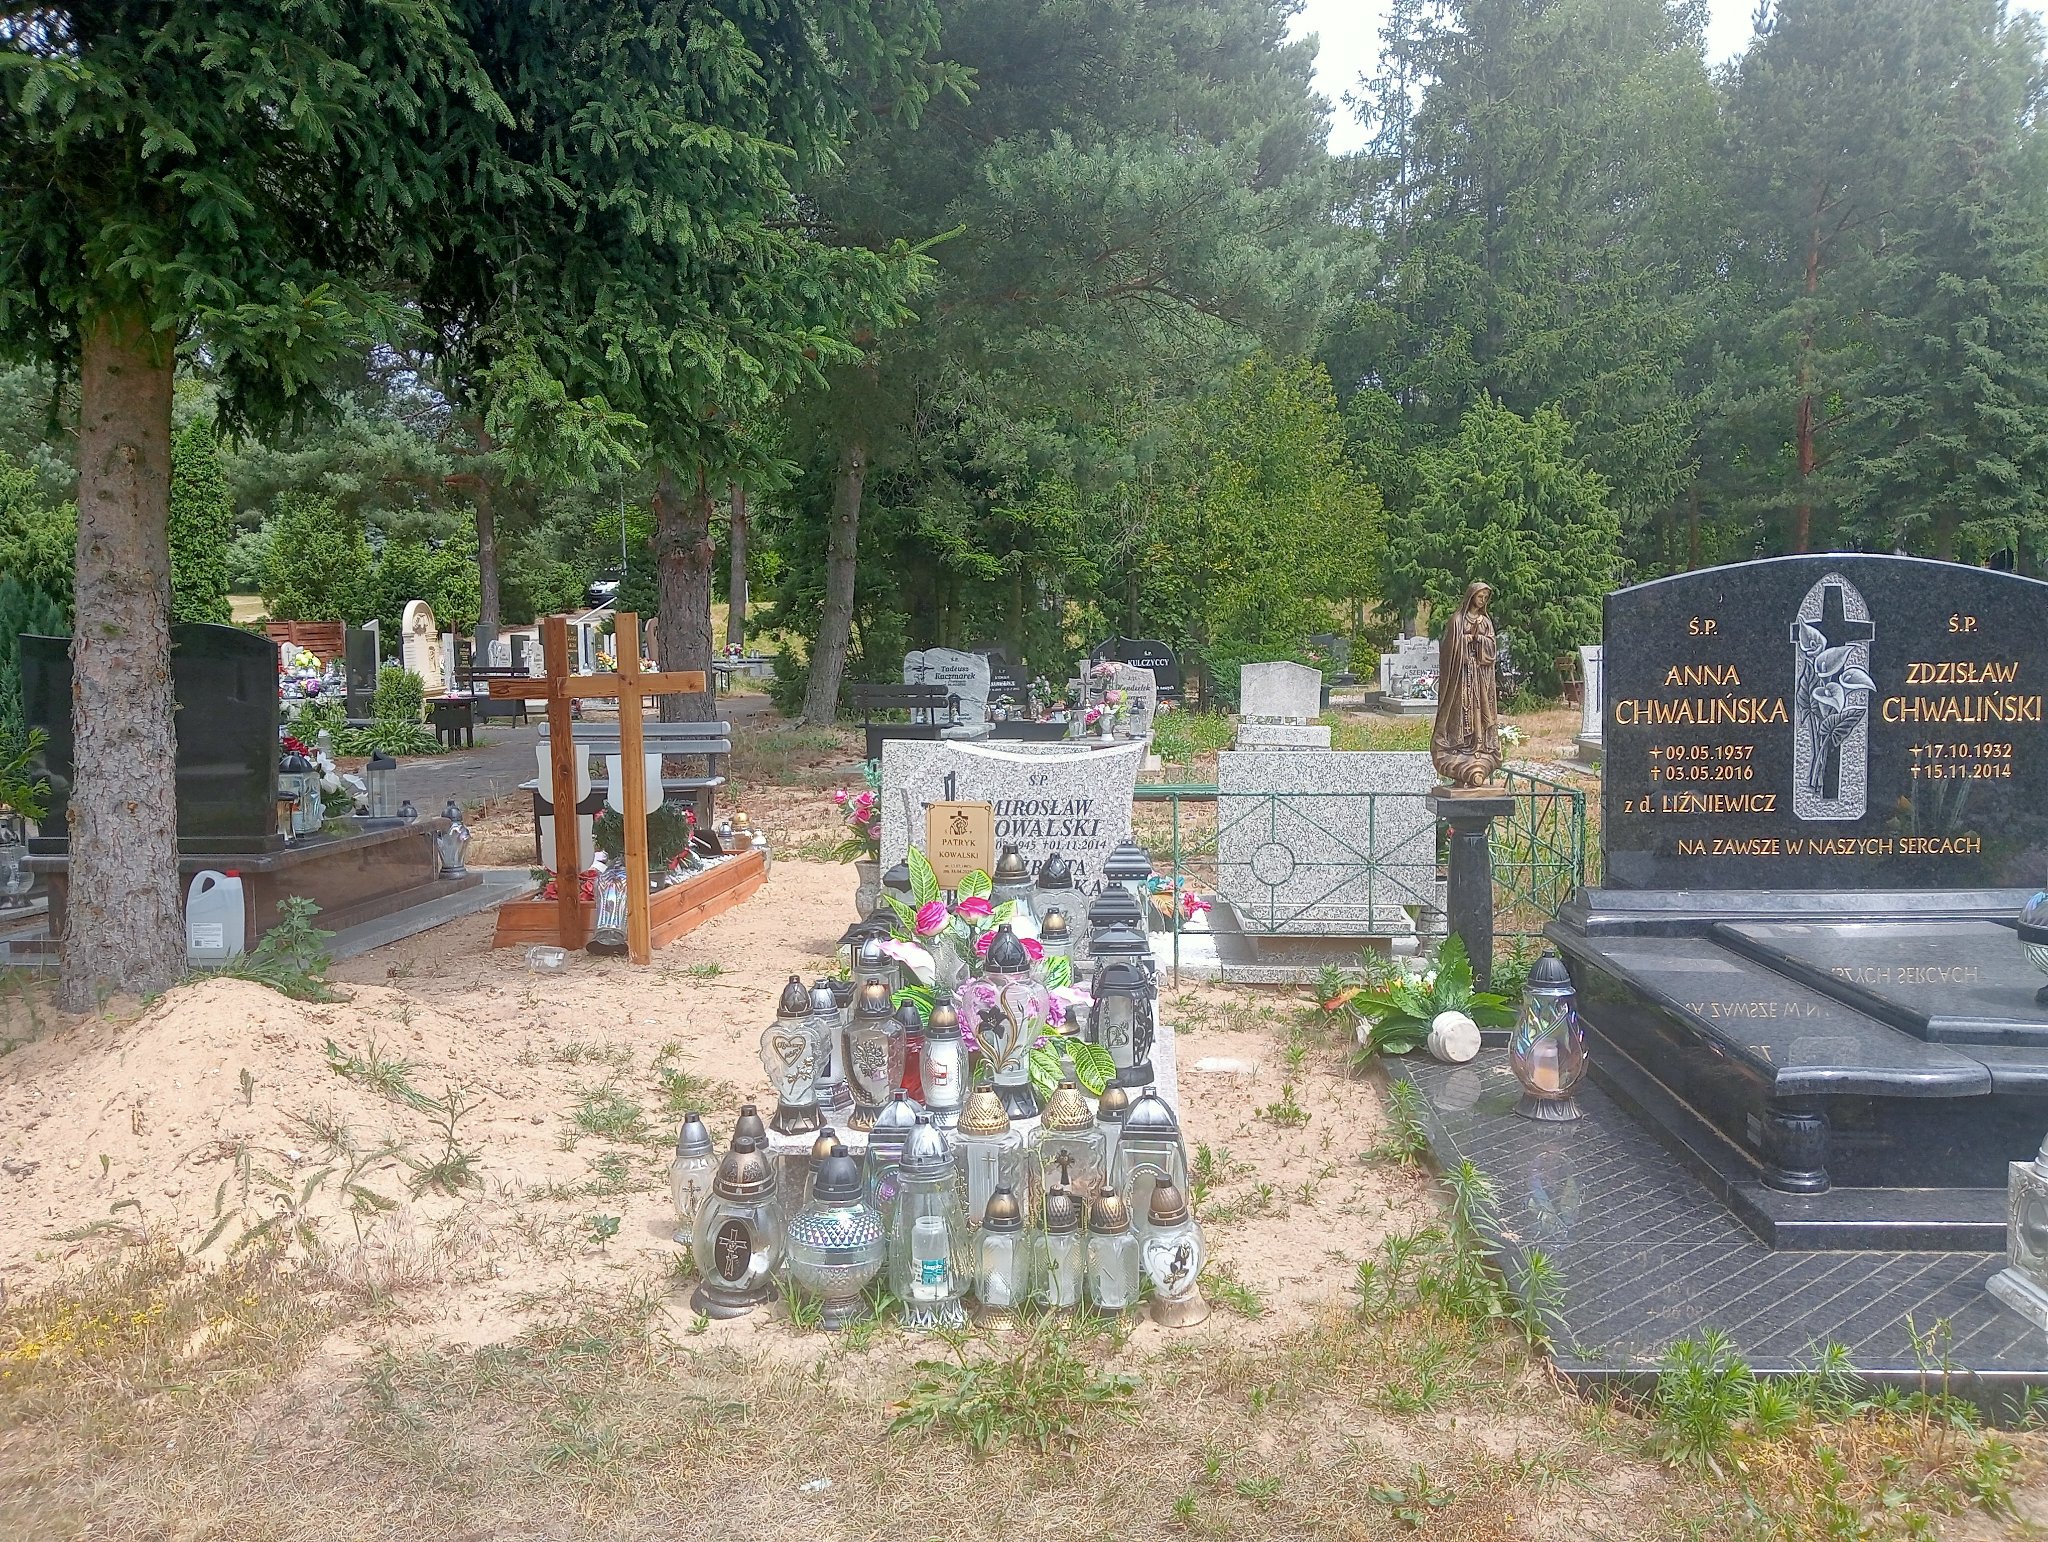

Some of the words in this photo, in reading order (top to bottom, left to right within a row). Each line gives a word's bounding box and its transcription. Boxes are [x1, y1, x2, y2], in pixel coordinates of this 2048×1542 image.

[1689, 616, 1718, 636] Ś.P.
[1948, 613, 1978, 633] Ś.P.
[1664, 664, 1741, 686] ANNA
[1905, 661, 2020, 684] ZDZISŁAW
[1615, 692, 1790, 725] CHWALIŃSKA
[1881, 690, 2043, 723] CHWALIŃSKI
[1666, 745, 1755, 760] 09.05.1937
[1924, 743, 2013, 758] 17.10.1932
[1666, 765, 1754, 781] 03.05.2016
[1924, 763, 2012, 779] 15.11.2014
[1661, 791, 1778, 813] LIŹNIEWICZ
[994, 818, 1101, 837] OWALSKI
[942, 838, 977, 847] PATRYK
[1677, 839, 1707, 855] NA
[1712, 839, 1781, 855] ZAWSZE
[1785, 838, 1804, 855] W
[1808, 838, 1893, 855] NASZYCH
[1899, 837, 1982, 854] SERCACH
[939, 851, 979, 859] KOWALSKI
